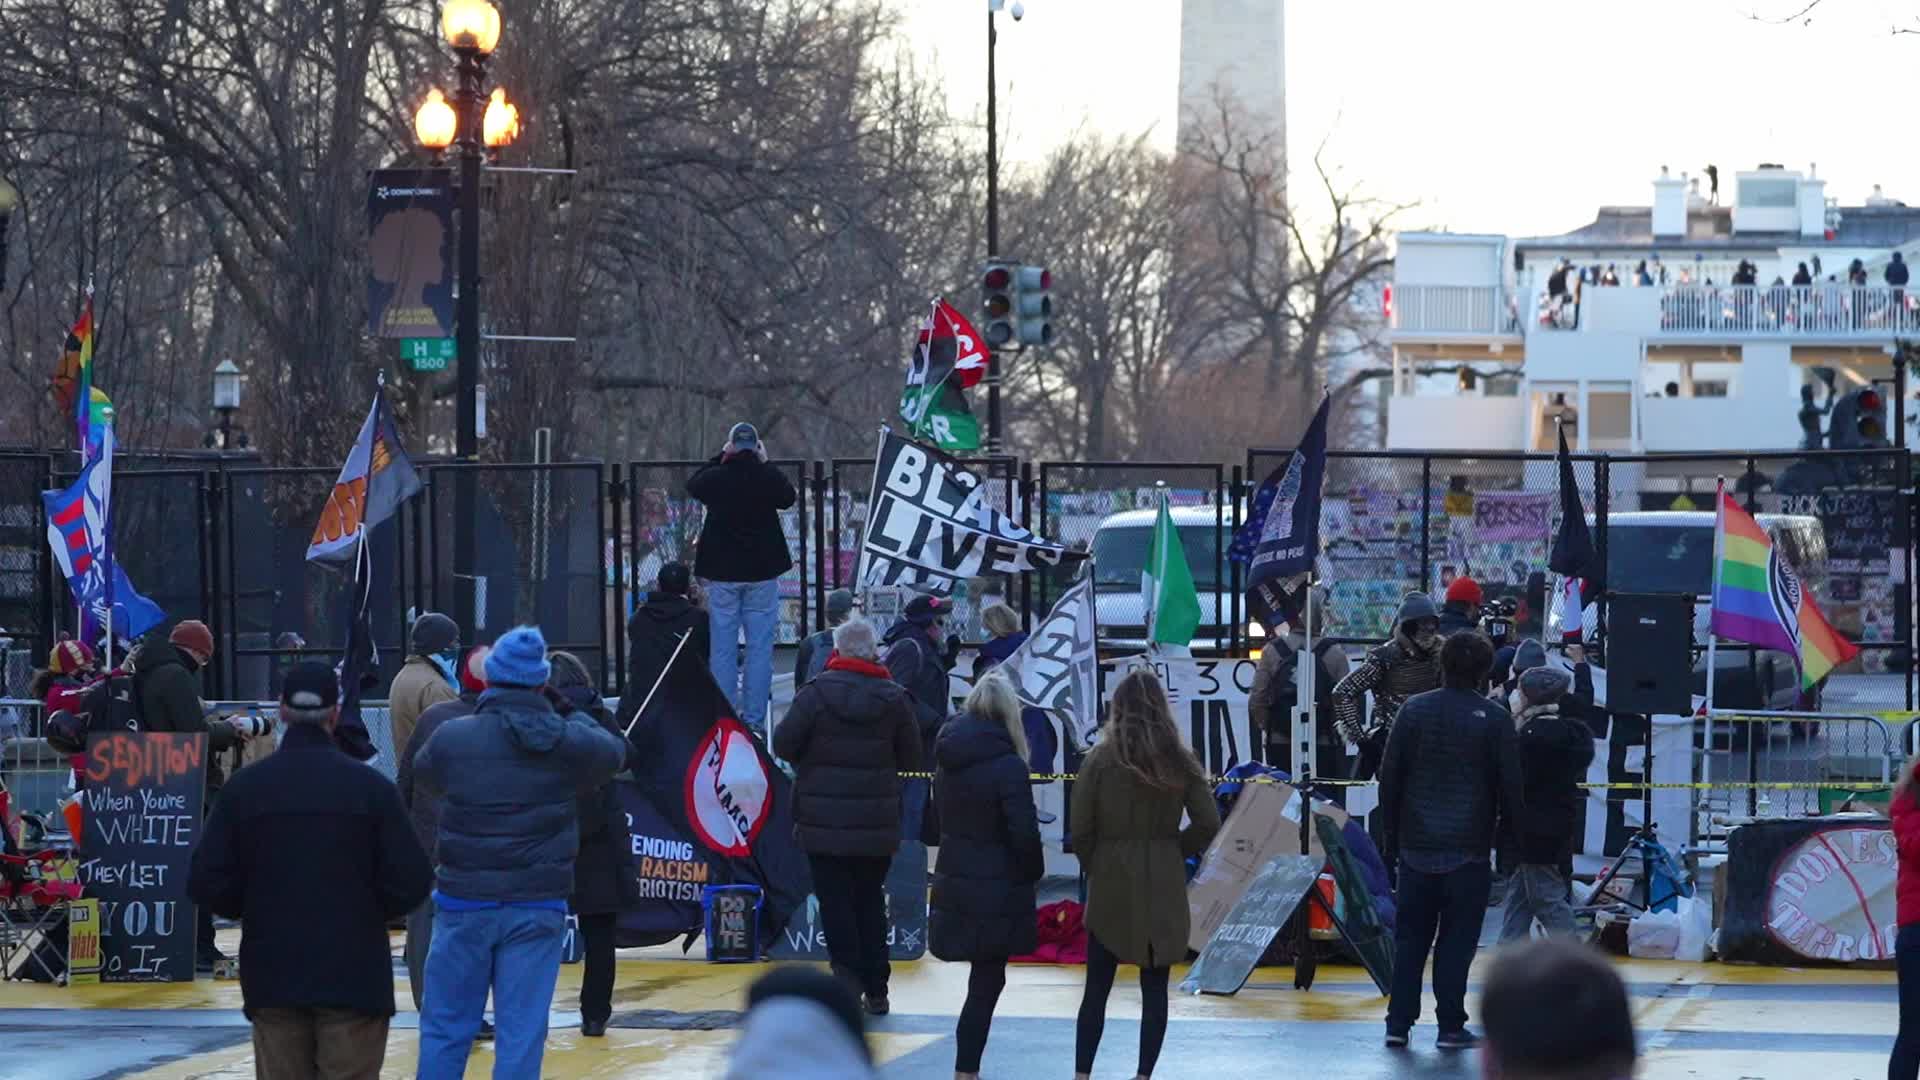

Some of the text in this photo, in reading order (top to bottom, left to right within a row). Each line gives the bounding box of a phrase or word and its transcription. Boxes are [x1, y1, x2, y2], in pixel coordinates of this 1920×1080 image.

[413, 341, 428, 357] H
[415, 357, 446, 369] 1500
[89, 736, 200, 785] SEDITION
[87, 787, 134, 812] When
[95, 814, 193, 846] WHITE
[629, 833, 694, 861] ENDING
[128, 859, 169, 889] LET
[640, 857, 709, 883] RACISM
[100, 901, 176, 936] YOU
